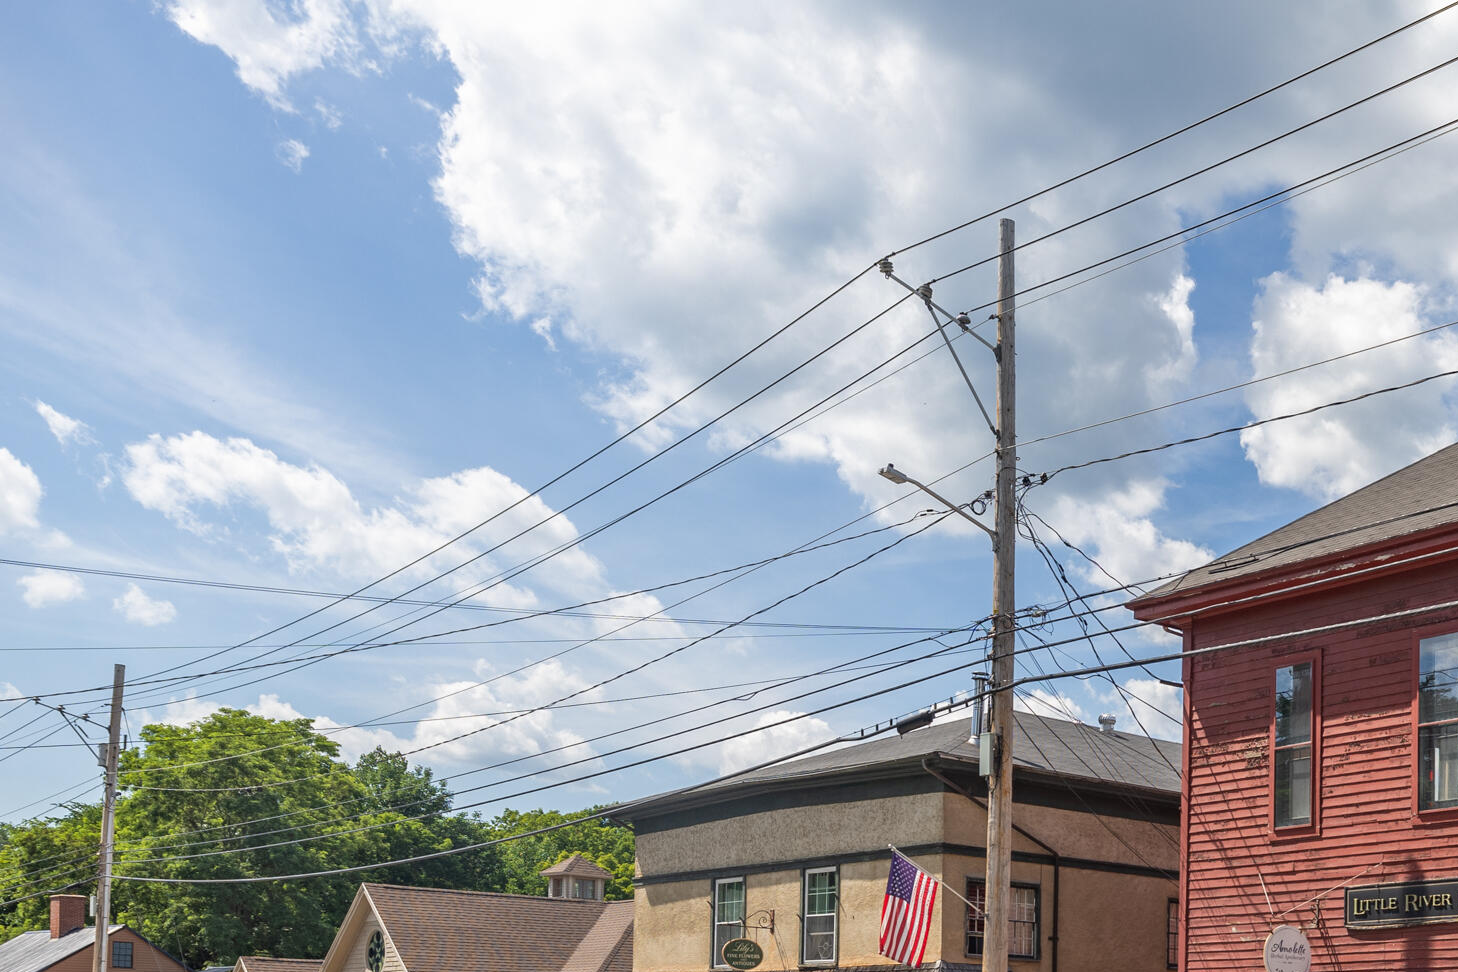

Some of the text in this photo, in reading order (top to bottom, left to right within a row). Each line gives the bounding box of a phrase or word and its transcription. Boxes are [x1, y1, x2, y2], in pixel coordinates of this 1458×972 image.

[1353, 897, 1398, 915] LITTLE
[1405, 893, 1452, 912] RIVER
[1271, 940, 1306, 955] Amolette
